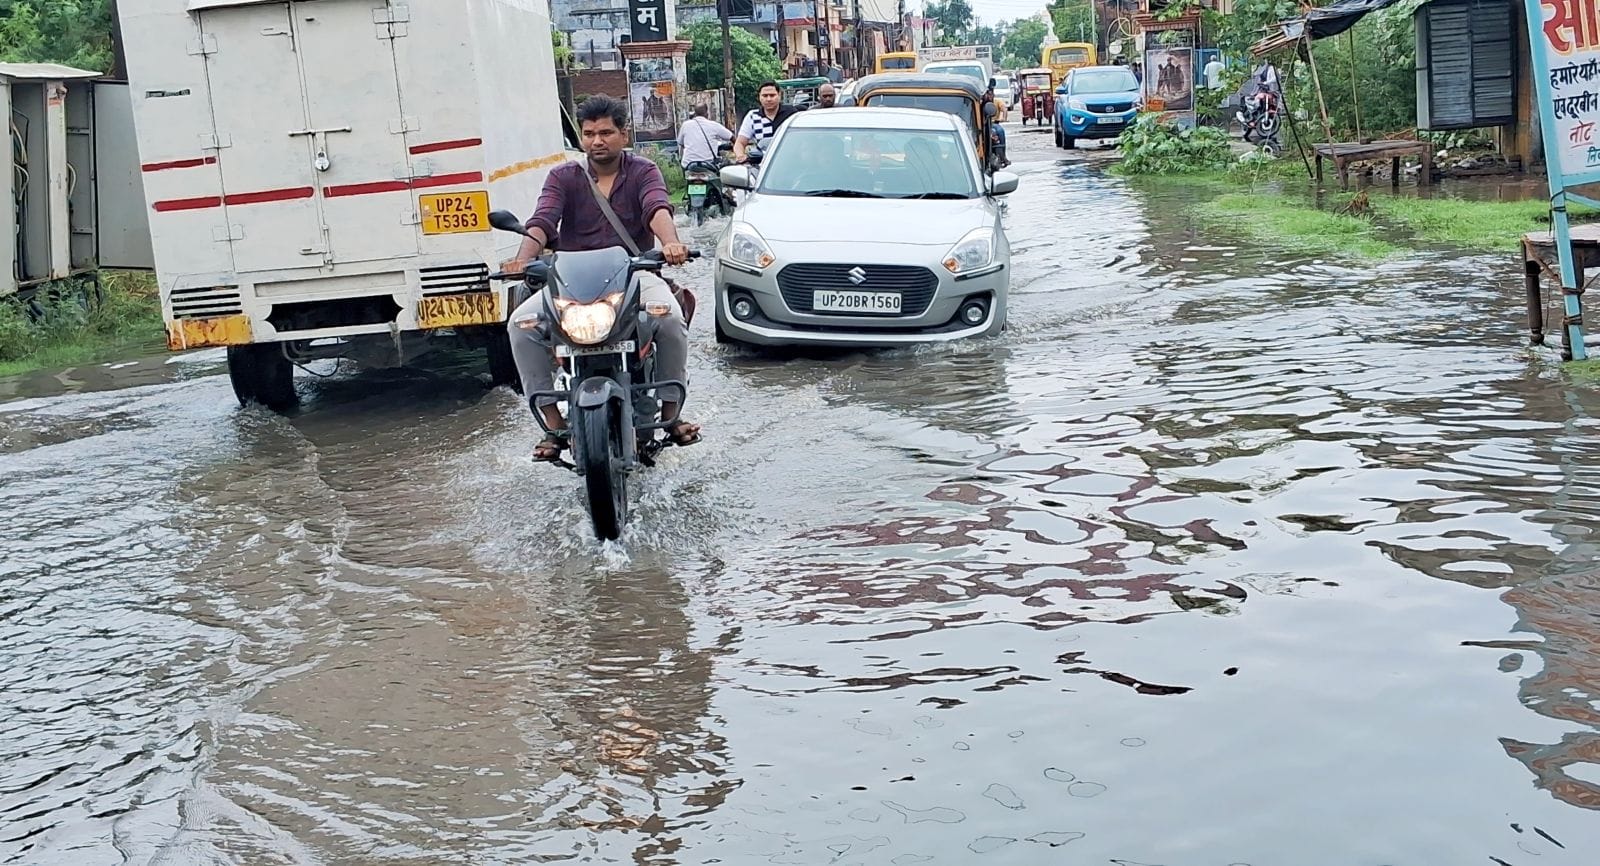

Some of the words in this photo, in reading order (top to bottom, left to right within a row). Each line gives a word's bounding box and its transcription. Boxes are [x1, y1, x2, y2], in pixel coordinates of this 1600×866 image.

[1550, 61, 1579, 90] हमारे
[436, 197, 472, 212] UP24
[434, 213, 478, 229] T5363
[822, 294, 900, 309] UP20BR1560
